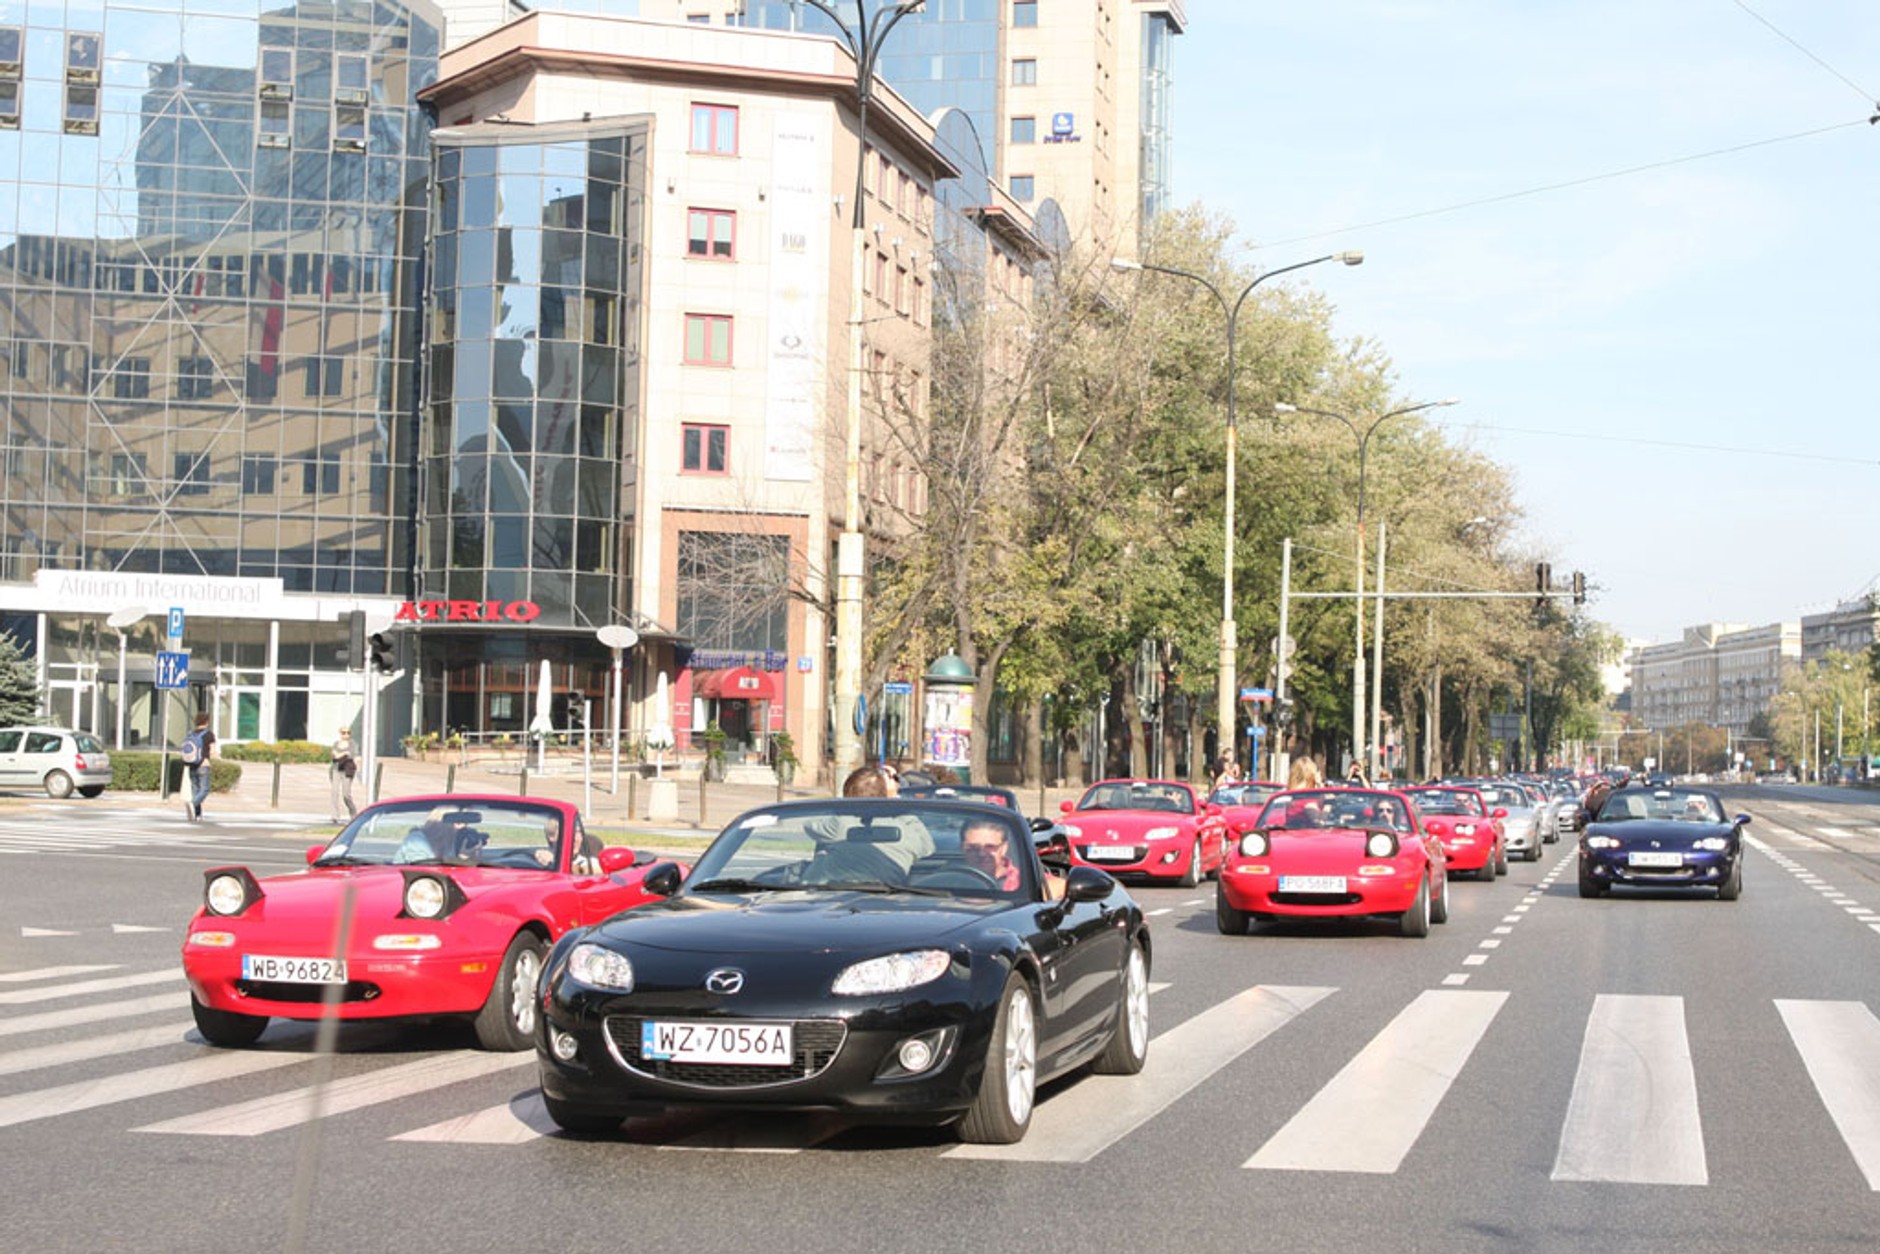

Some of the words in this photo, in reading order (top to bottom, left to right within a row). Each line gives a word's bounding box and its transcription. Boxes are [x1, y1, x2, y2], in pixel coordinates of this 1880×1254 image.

[58, 575, 127, 598] Atrium
[135, 577, 261, 604] International
[395, 599, 541, 622] ATRIO
[253, 959, 279, 979] WB
[285, 960, 346, 981] 96824
[659, 1026, 695, 1052] WZ
[705, 1026, 786, 1054] 7056A
